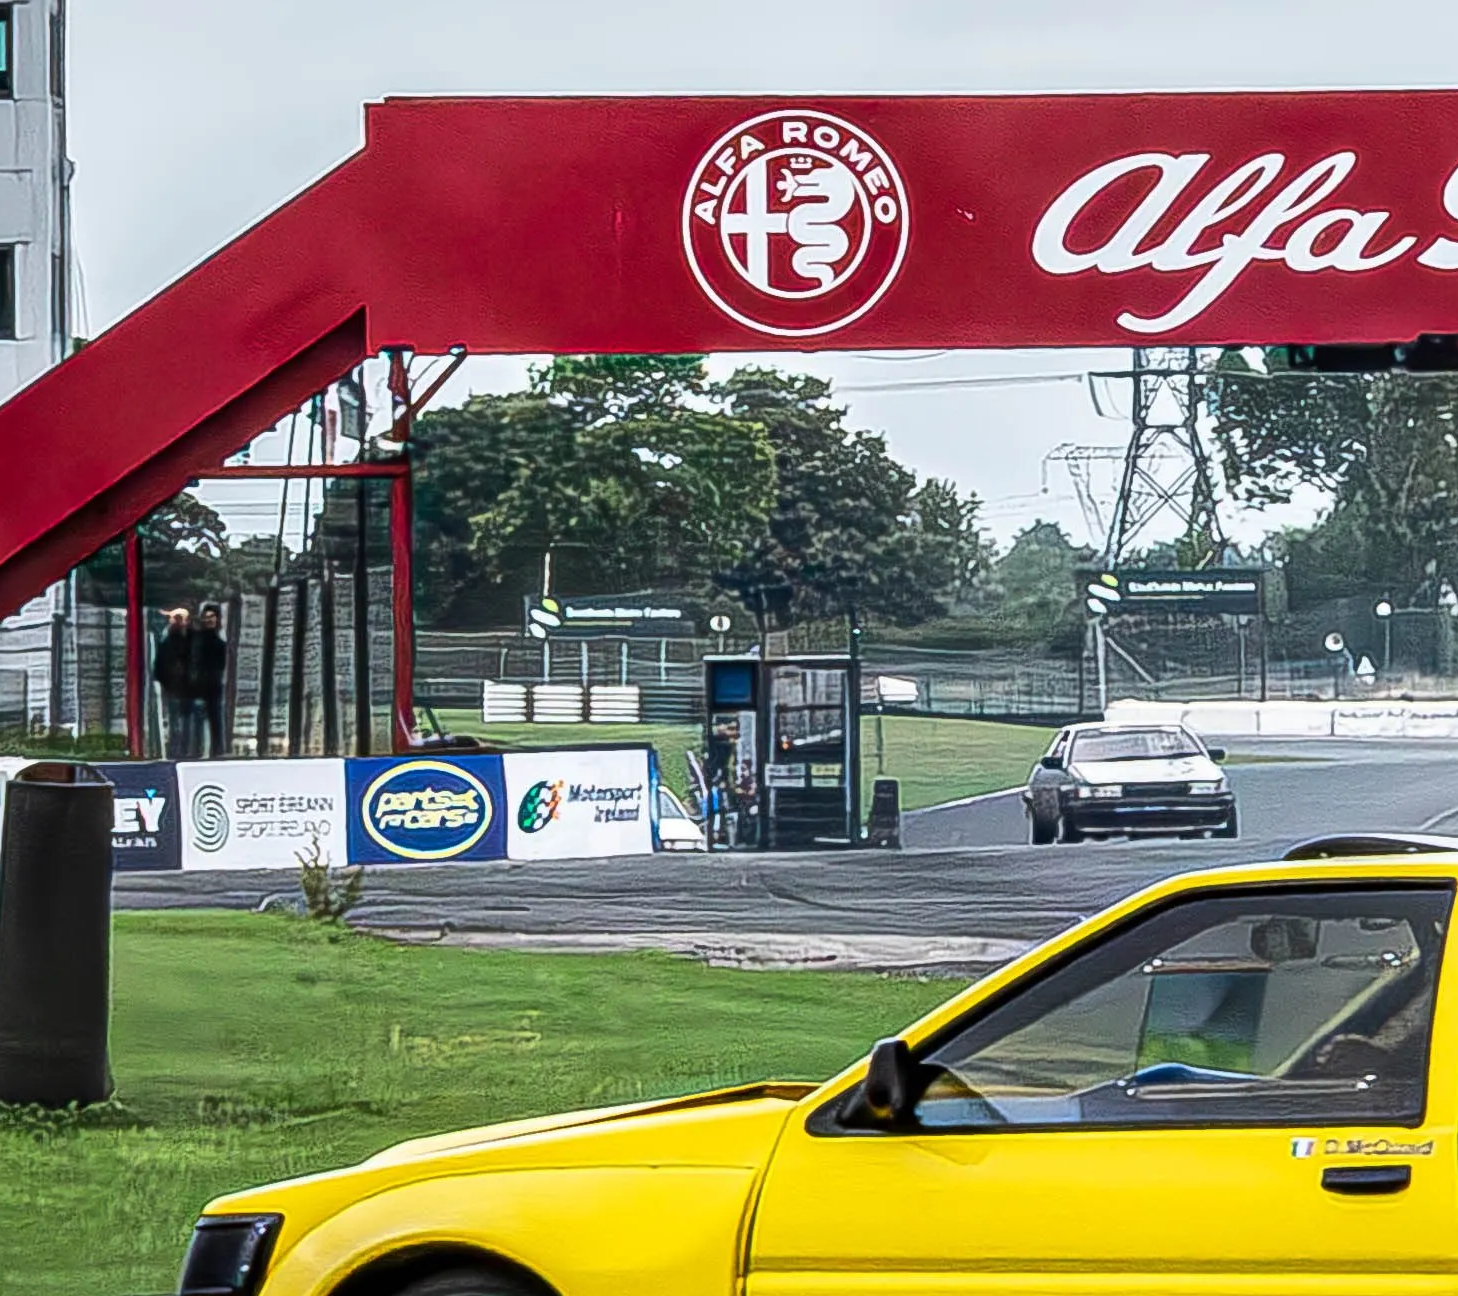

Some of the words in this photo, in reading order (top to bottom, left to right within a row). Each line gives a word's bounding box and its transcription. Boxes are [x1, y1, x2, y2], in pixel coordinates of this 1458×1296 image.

[694, 134, 765, 225] ALFA
[782, 121, 897, 224] ROMEO
[1031, 151, 1417, 333] Alfa
